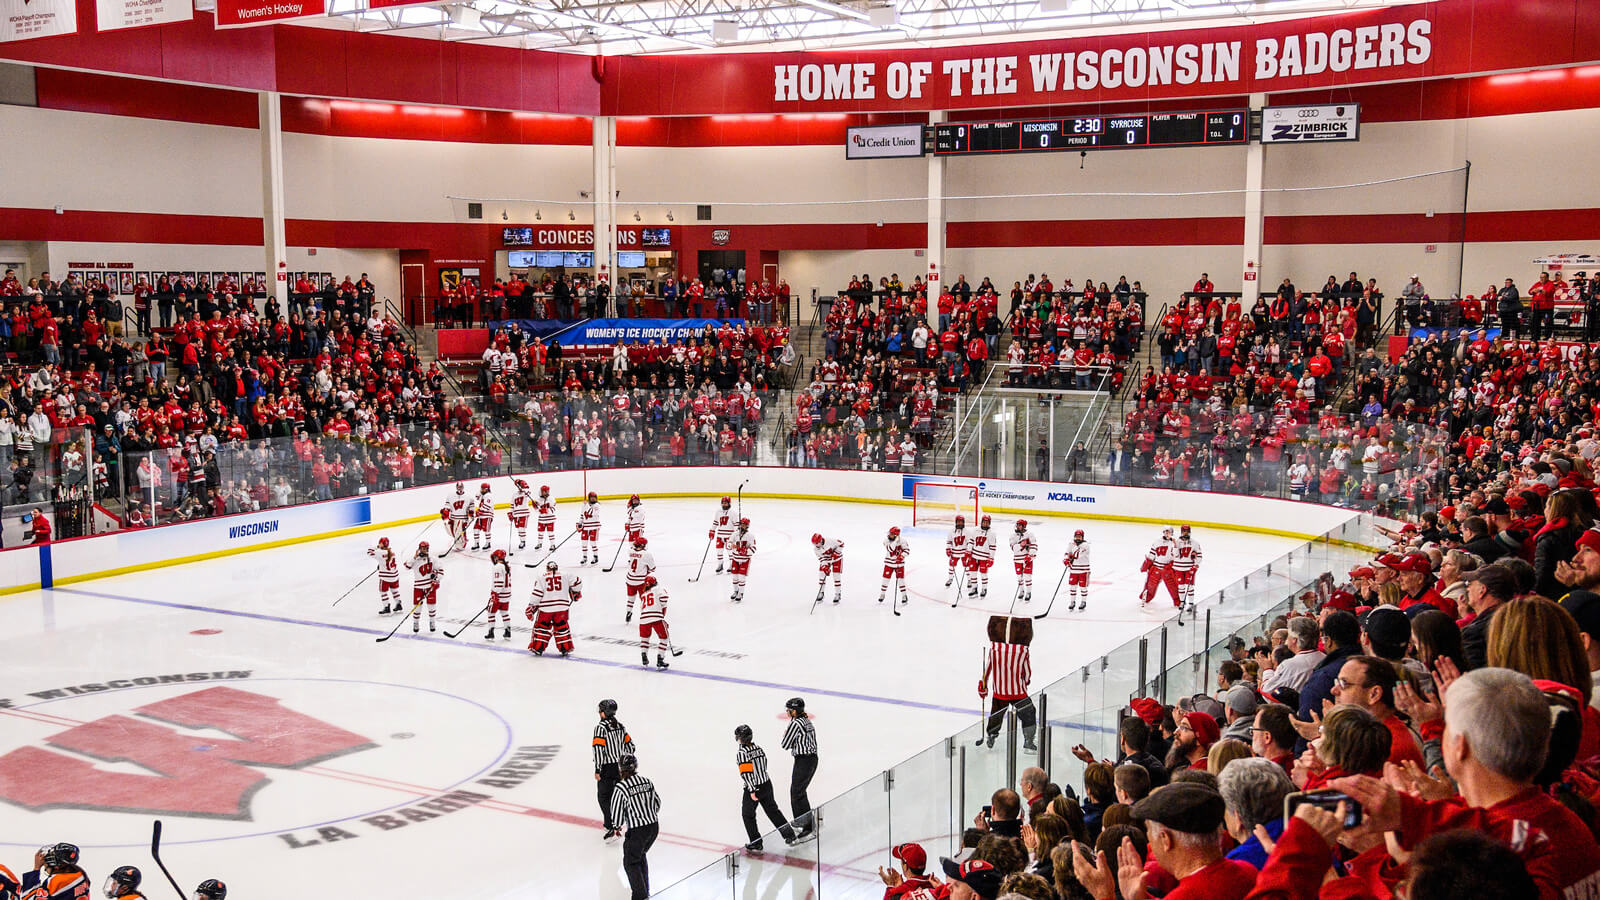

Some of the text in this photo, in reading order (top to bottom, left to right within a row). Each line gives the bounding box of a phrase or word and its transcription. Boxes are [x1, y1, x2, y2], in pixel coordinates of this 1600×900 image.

[238, 3, 302, 19] Women's Hockey
[774, 19, 1432, 101] HOME OF THE WISCONSIN BADGERS
[1074, 118, 1101, 133] 2:30
[1110, 119, 1144, 129] SYRACUSE
[1232, 114, 1241, 126] 0
[957, 126, 965, 138] 0
[1023, 122, 1058, 133] WISCONSIN
[1293, 122, 1348, 133] ZIMBRICK
[866, 137, 891, 148] Credit
[892, 136, 916, 147] Union
[1040, 133, 1049, 148] 0
[1067, 135, 1096, 145] PERIOD 1
[1126, 130, 1135, 144] 0
[586, 327, 625, 339] WOMEN'S
[626, 327, 641, 338] ICE
[641, 327, 676, 338] HOCKEY
[1002, 493, 1036, 501] CHAMPIONSHIP
[1048, 492, 1096, 504] NCAA.com
[229, 519, 279, 539] WISCONSIN
[631, 558, 637, 572] 4
[545, 575, 562, 592] 35
[27, 669, 253, 700] WISCONSIN
[277, 744, 563, 849] LA BAHN ARENA
